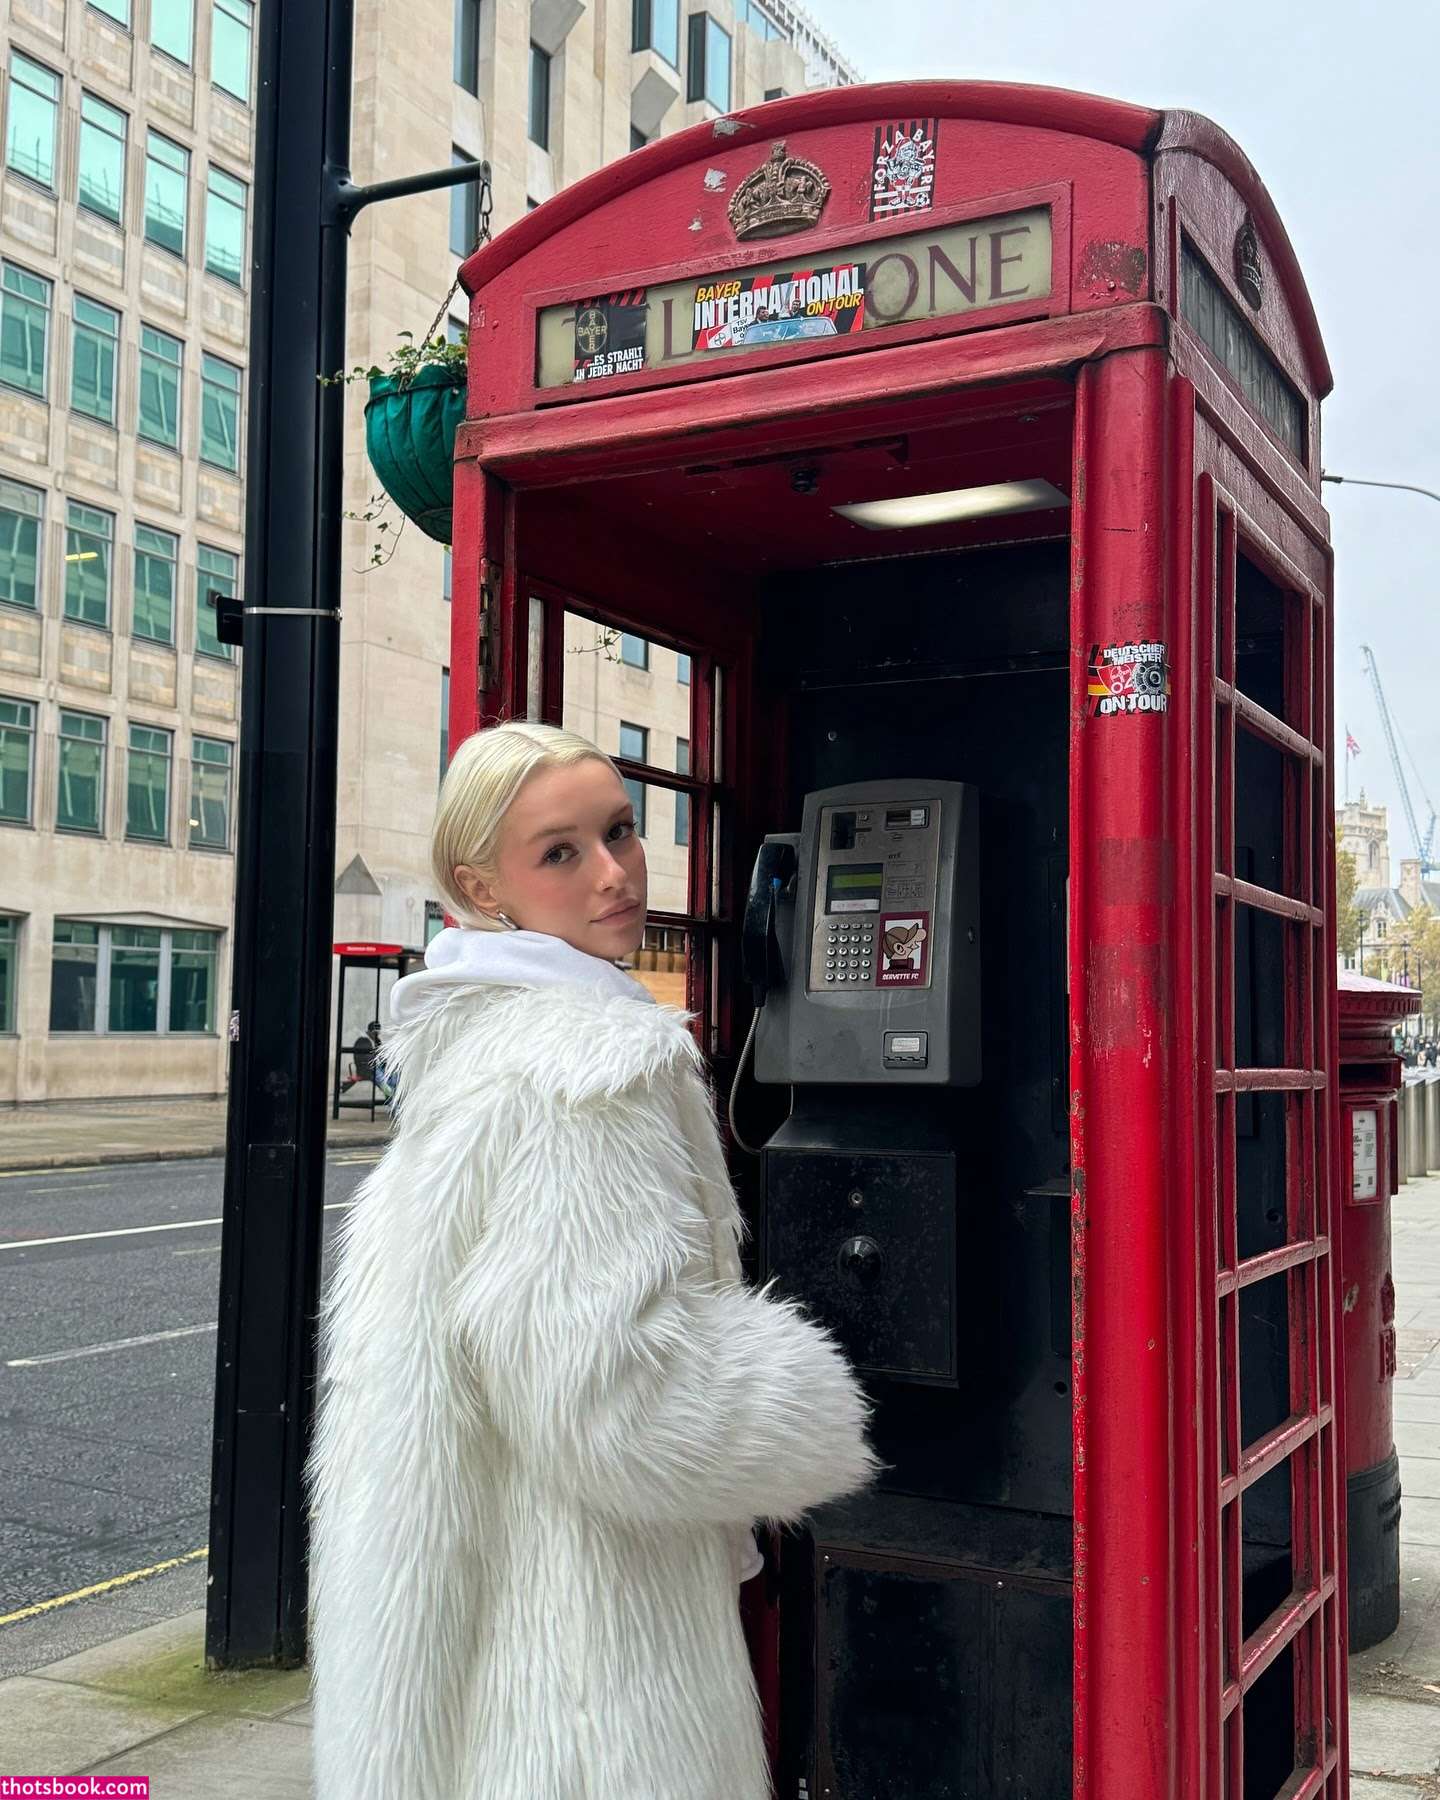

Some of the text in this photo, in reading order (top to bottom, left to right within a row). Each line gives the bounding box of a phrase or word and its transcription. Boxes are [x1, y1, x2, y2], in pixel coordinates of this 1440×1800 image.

[912, 128, 935, 185] BAYER
[697, 281, 741, 303] BAYER
[806, 293, 862, 316] ON TOUR
[577, 325, 607, 336] BAYER
[607, 346, 643, 364] STRAHLT
[576, 358, 643, 380] IN JEDER NACHT
[1103, 643, 1165, 659] DEUTSCHER
[1112, 653, 1162, 666] MEISTER
[1100, 693, 1167, 714] ON TOUR
